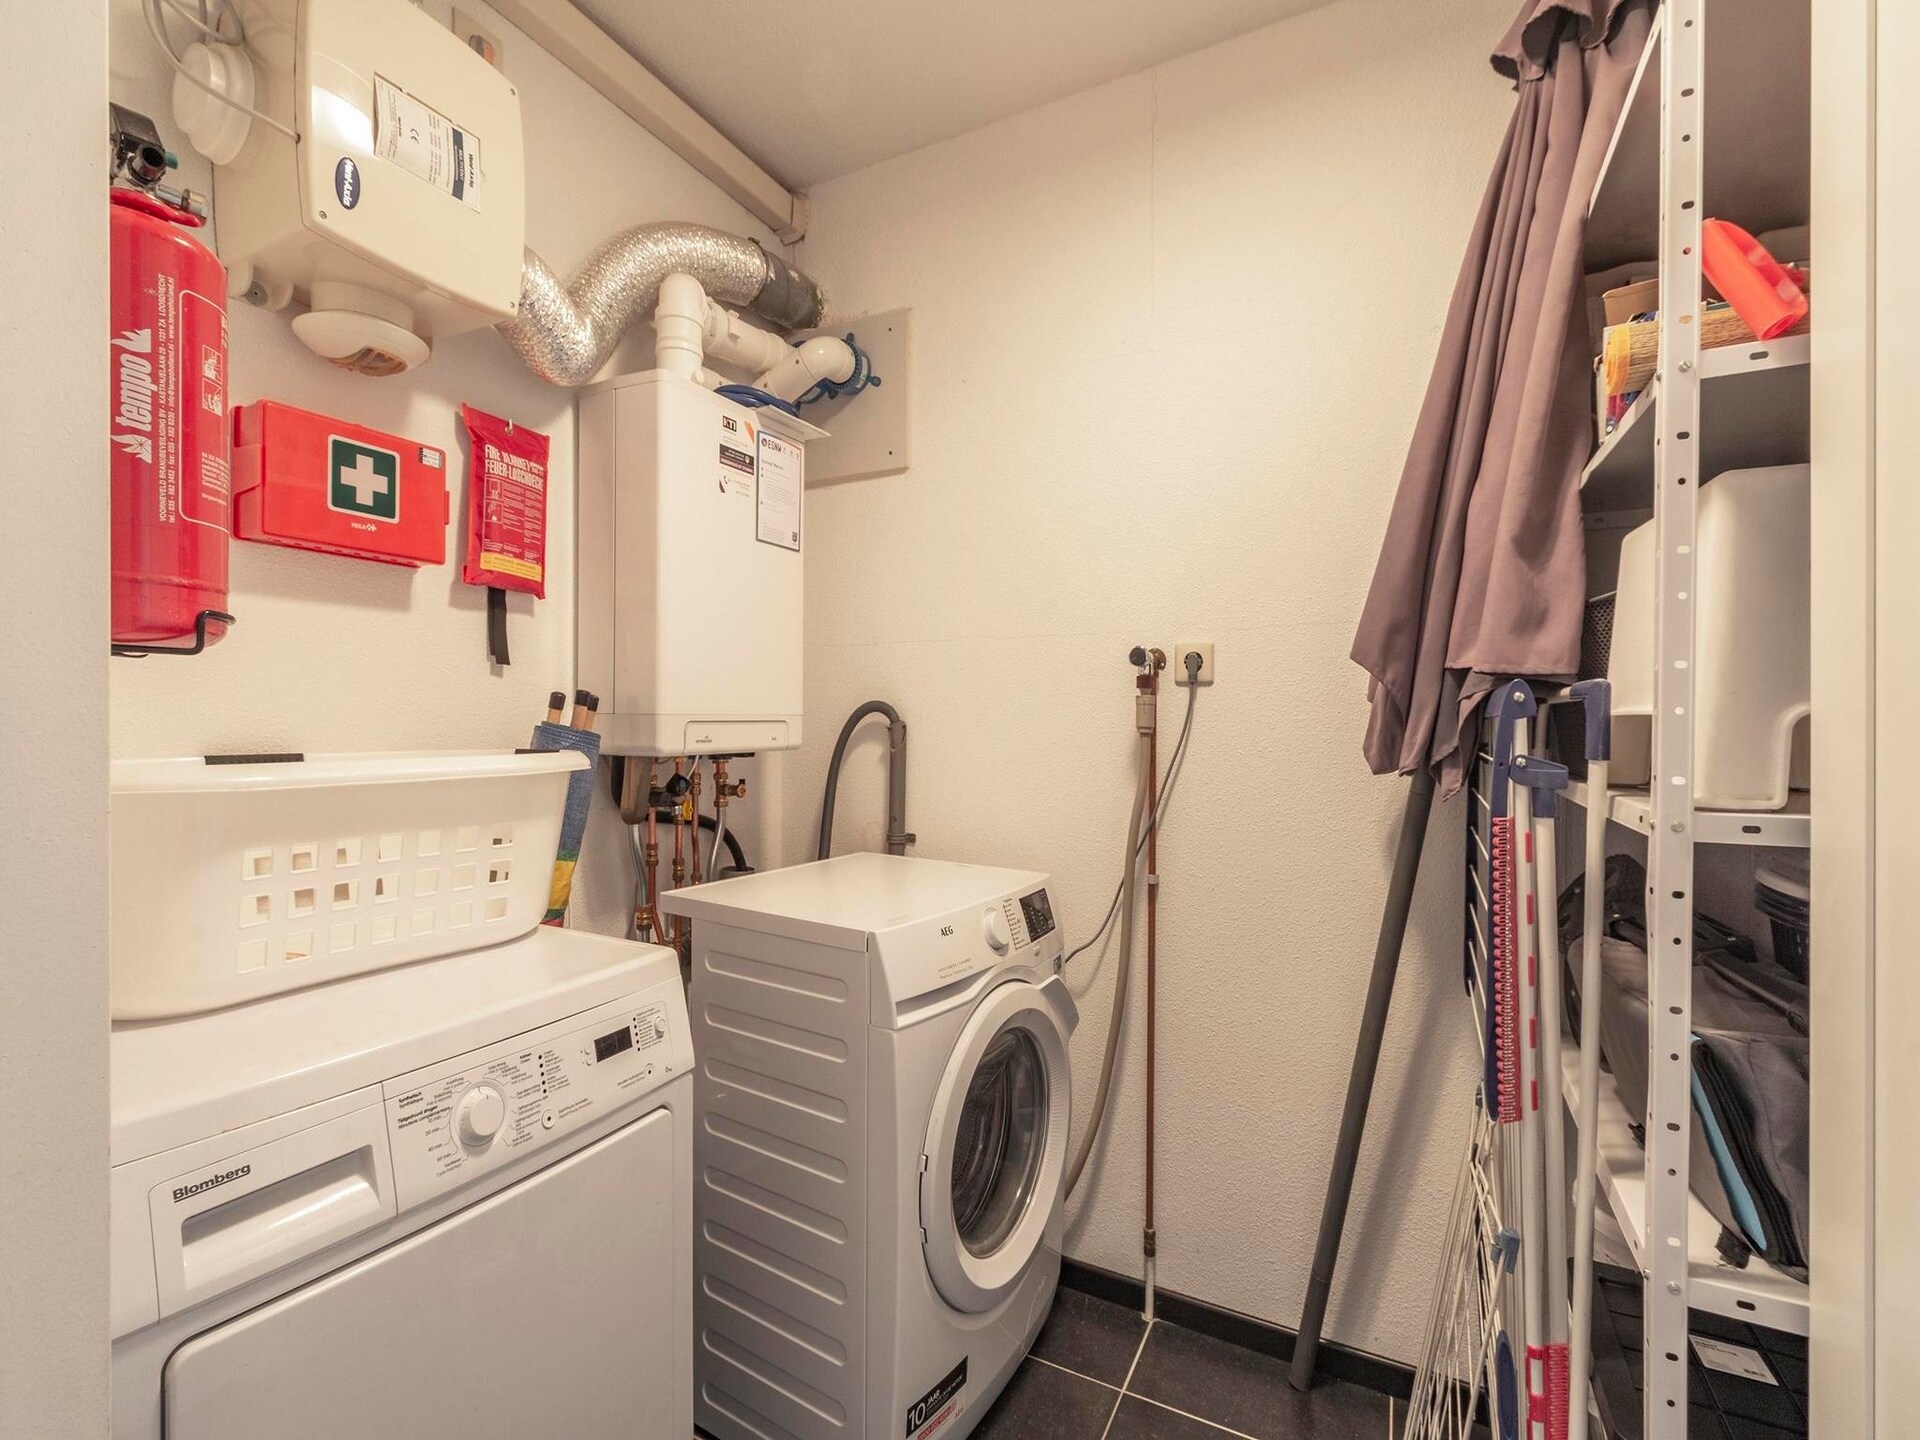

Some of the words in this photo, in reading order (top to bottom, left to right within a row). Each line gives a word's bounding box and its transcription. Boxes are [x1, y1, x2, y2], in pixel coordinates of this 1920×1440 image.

[342, 158, 355, 208] Vent-Axia
[158, 273, 166, 316] LOOSDRECHT
[115, 352, 158, 431] tempo
[159, 409, 166, 418] BV
[485, 444, 501, 461] FIRE
[940, 925, 954, 938] AEG
[172, 1163, 251, 1201] Blomberg
[908, 1402, 926, 1431] 10
